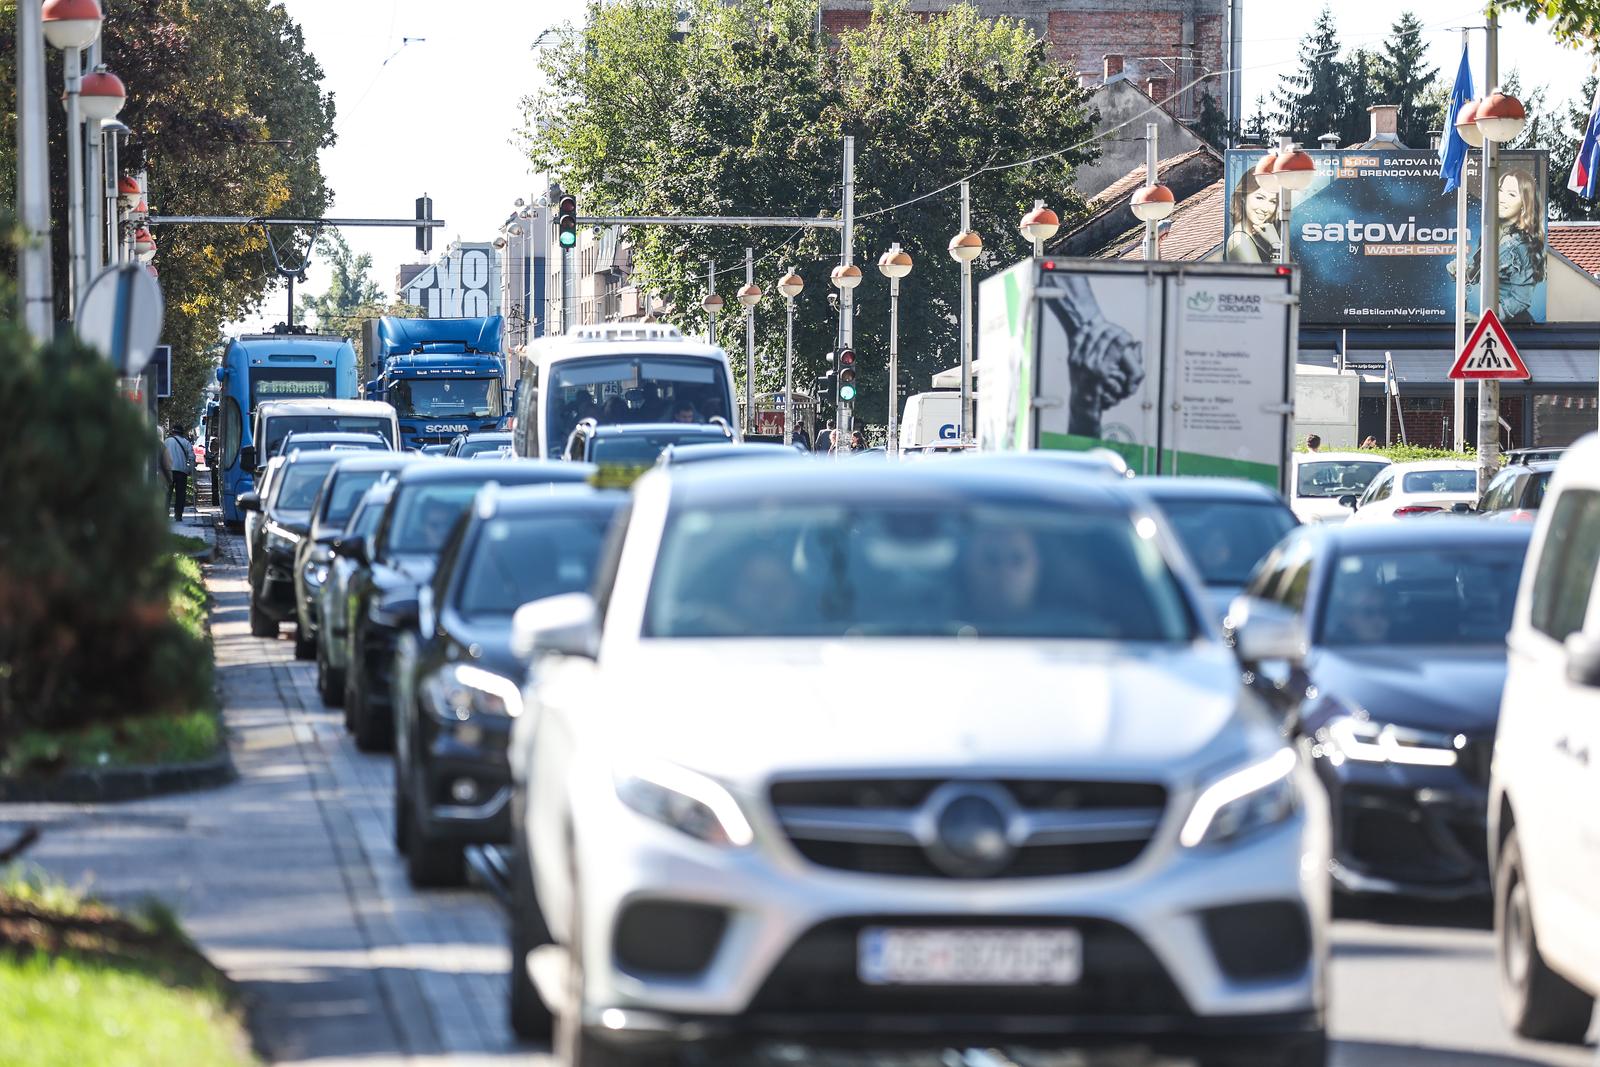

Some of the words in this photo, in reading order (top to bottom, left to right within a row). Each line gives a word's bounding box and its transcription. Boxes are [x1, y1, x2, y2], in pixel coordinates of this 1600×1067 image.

[1349, 244, 1358, 255] by
[1366, 246, 1412, 254] WATCH
[1218, 294, 1261, 304] REMAR
[1344, 308, 1446, 316] #SaStilomNaVrijeme
[426, 424, 469, 432] SCANIA
